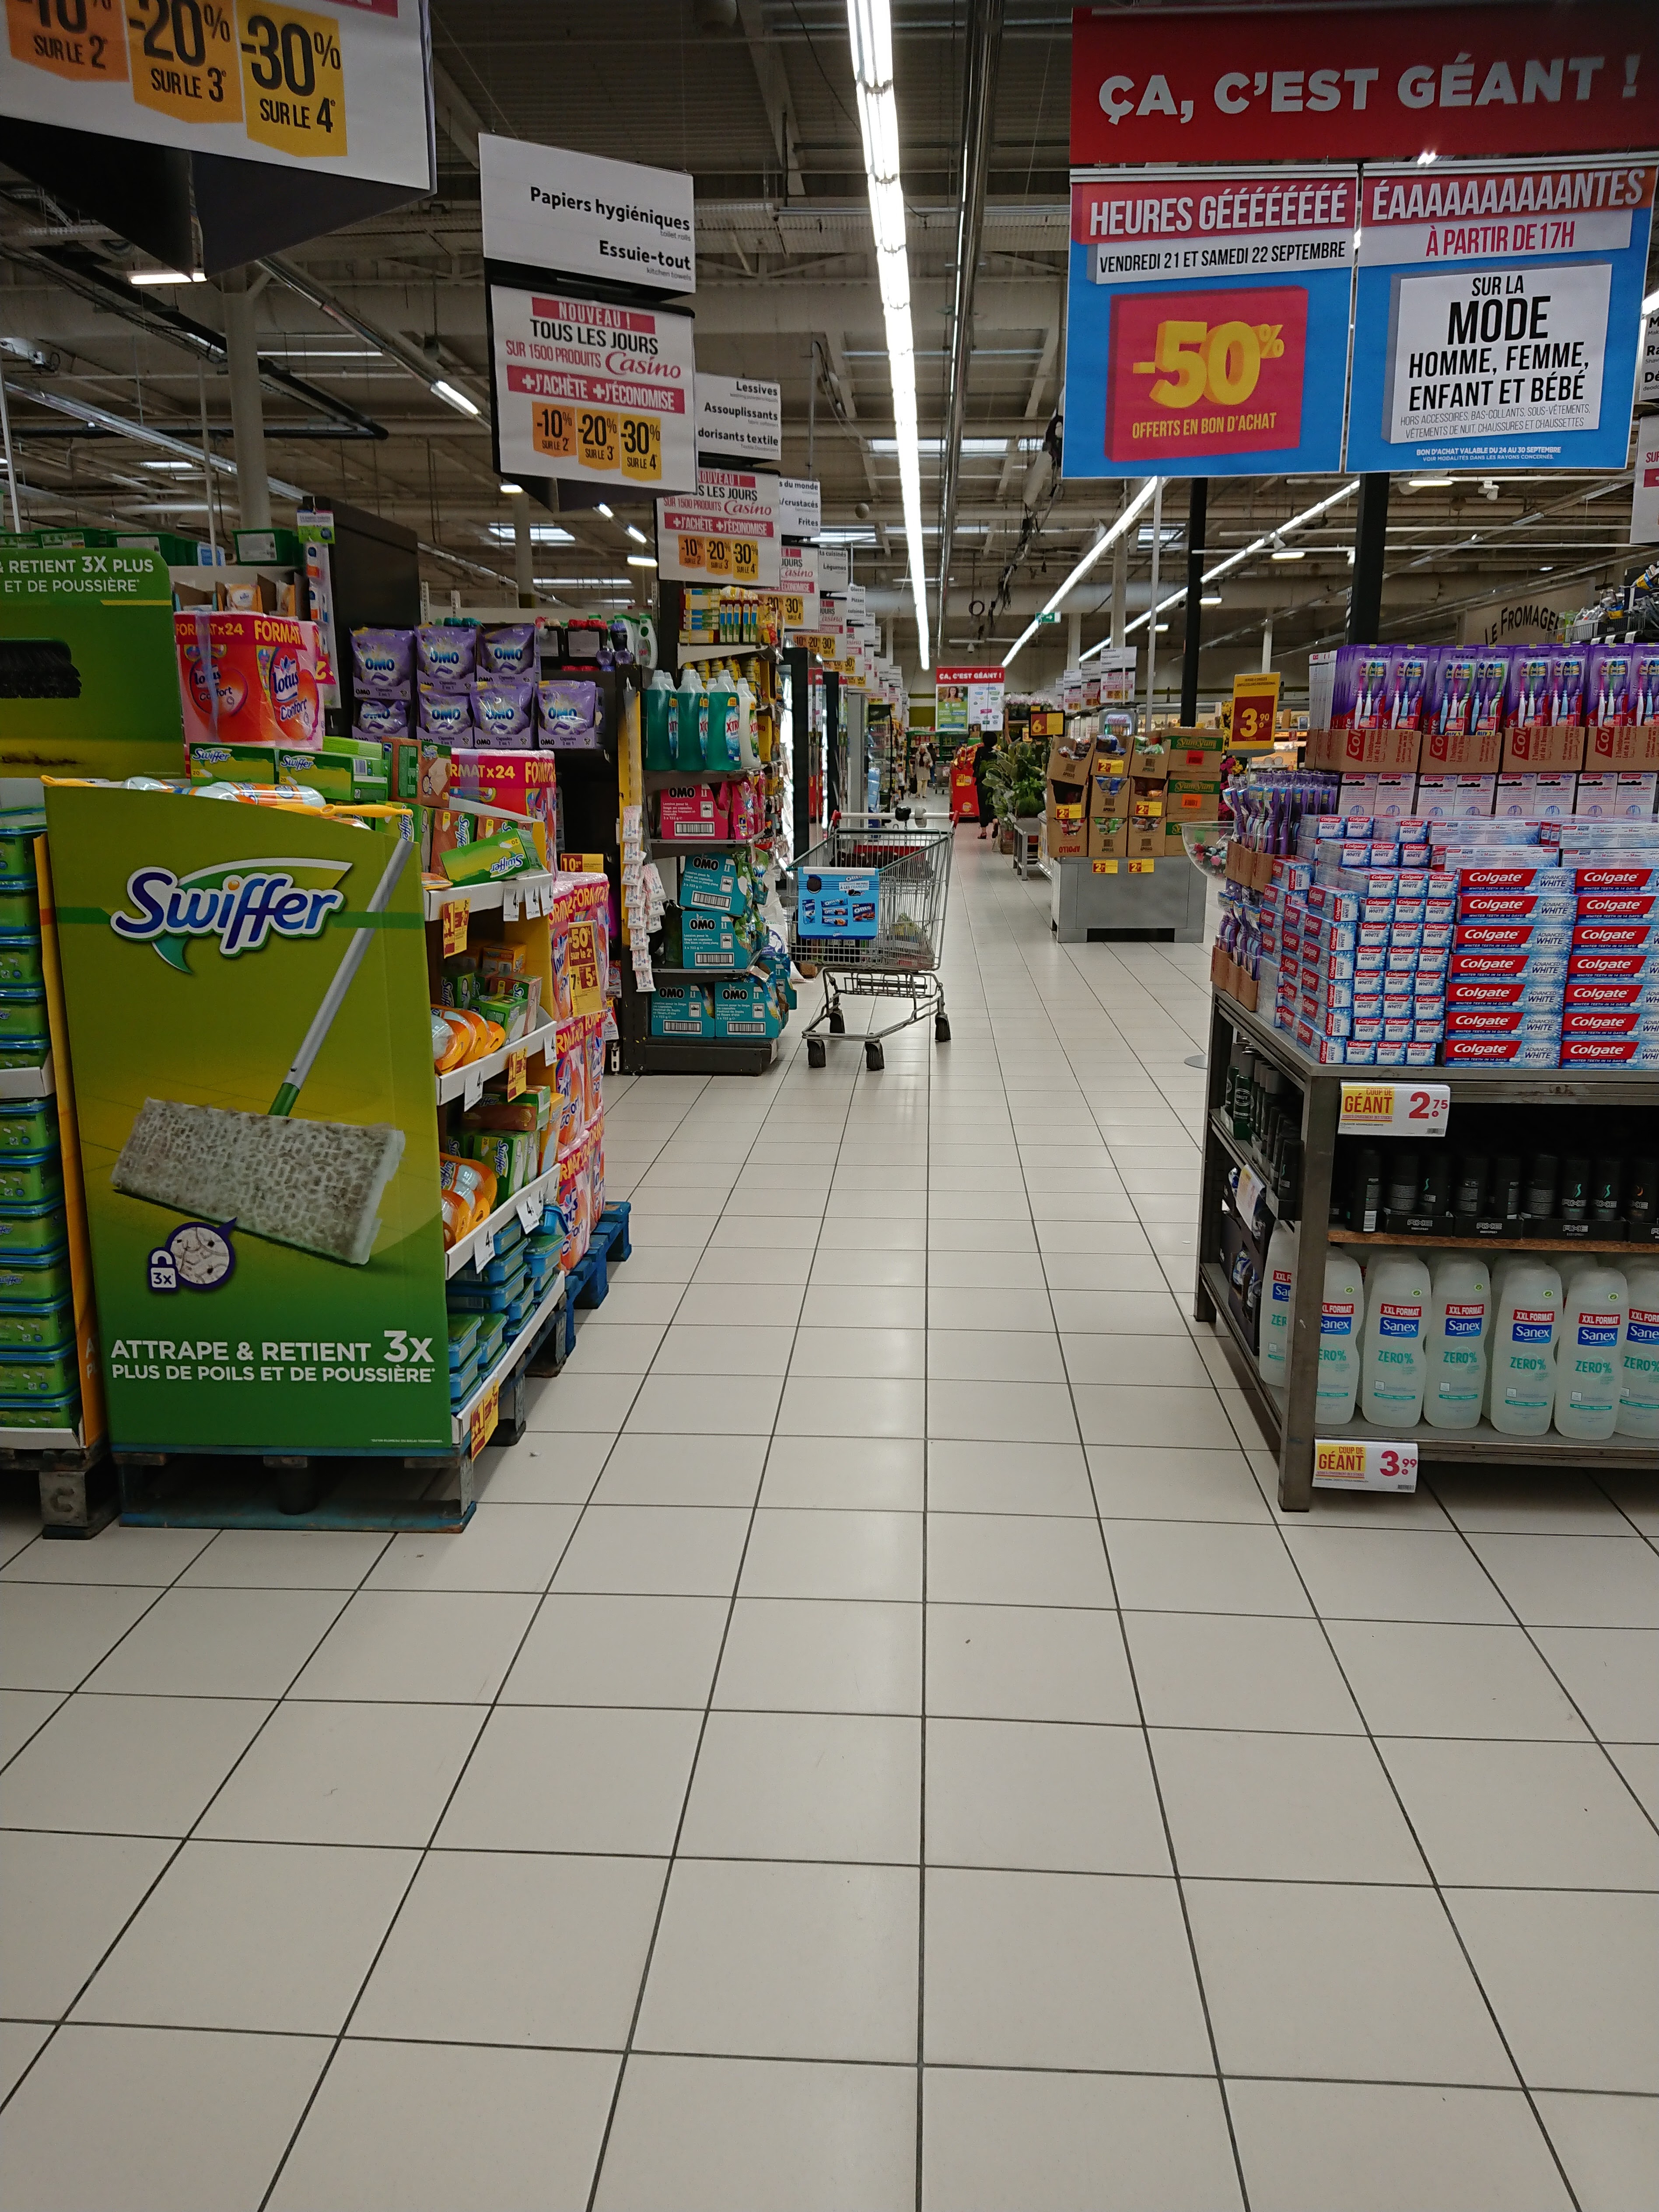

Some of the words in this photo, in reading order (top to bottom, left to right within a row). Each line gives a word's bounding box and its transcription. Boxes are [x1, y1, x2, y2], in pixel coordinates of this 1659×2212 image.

[33, 35, 64, 61] SUR
[66, 42, 85, 65] LE
[242, 15, 341, 97] -30%
[150, 68, 182, 96] SUR
[183, 74, 203, 99] LE
[1099, 75, 1194, 125] ÇA,
[1214, 68, 1379, 114] C'EST
[1398, 52, 1605, 109] GÉANT
[260, 98, 290, 126] SUR
[293, 104, 311, 130] LE
[530, 186, 592, 212] Papiers
[595, 199, 690, 231] hygiéniques
[1090, 196, 1193, 237] HEURES
[1425, 225, 1438, 257] À
[1444, 225, 1508, 256] PARTIR
[1512, 224, 1537, 251] DE
[1540, 220, 1575, 249] 17H
[599, 240, 692, 271] Essuie-tout
[1100, 252, 1160, 273] VENDREDI
[1164, 252, 1179, 268] 21
[1183, 250, 1199, 268] ET
[1201, 247, 1249, 267] SAMEDI
[1252, 246, 1268, 263] 22
[1271, 241, 1346, 262] SEPTEMBRE
[1471, 276, 1502, 297] SUR
[1505, 275, 1525, 294] LA
[558, 301, 621, 327] NOUVEAU
[1447, 295, 1551, 346] MODE
[529, 318, 574, 343] TOUS
[578, 326, 607, 347] LES
[612, 332, 659, 355] JOURS
[506, 340, 526, 358] SUR
[528, 343, 554, 361] 1500
[556, 348, 601, 369] PRODUITS
[605, 351, 682, 379] Casino
[1133, 320, 1284, 409] -50%
[1408, 348, 1497, 379] HOMME,
[1506, 341, 1589, 371] FEMME,
[736, 381, 778, 396] Lessives
[1409, 380, 1493, 412] ENFANT
[1499, 378, 1526, 405] ET
[1531, 370, 1586, 402] BÉBÉ
[705, 402, 778, 421] Assouplissants
[1133, 420, 1180, 439] OFFERTS
[1183, 419, 1198, 436] EN
[1201, 417, 1224, 434] BON
[1227, 413, 1277, 433] D'ACHAT
[1400, 416, 1419, 427] HORS
[1406, 425, 1448, 439] VÊTEMENTS
[1449, 425, 1458, 435] DE
[1477, 420, 1523, 433] CHAUSSURES
[1524, 420, 1534, 430] ET
[1535, 416, 1584, 429] CHAUSSETTES
[537, 409, 572, 438] -10%
[578, 413, 617, 446] -20%
[620, 420, 661, 455] -30%
[747, 432, 778, 446] textile
[542, 439, 553, 449] SUR
[585, 449, 598, 459] SUR
[627, 457, 640, 468] SUR
[707, 486, 725, 498] LES
[728, 488, 758, 501] JOURS
[795, 481, 818, 490] monde
[693, 499, 721, 511] PRODUITS
[724, 500, 772, 516] Casino
[798, 517, 818, 526] Frites
[9, 559, 76, 574] RETIENT
[113, 558, 154, 573] PLUS
[4, 580, 22, 592] ET
[28, 579, 48, 592] DE
[430, 651, 459, 664] OMO
[494, 648, 523, 661] OMO
[365, 658, 394, 672] OMO
[192, 748, 231, 763] Swiffer
[281, 755, 316, 771] Swiffer
[1469, 872, 1522, 884] Colgate
[1584, 872, 1637, 884] Colgate
[112, 869, 341, 953] Swiffer
[1470, 899, 1523, 911] Colgate
[1587, 900, 1640, 912] Colgate
[1366, 1088, 1382, 1096] COUP
[1344, 1093, 1393, 1113] GÉANT
[1383, 1306, 1396, 1314] XXL
[1396, 1306, 1420, 1316] FORMAT
[1449, 1306, 1461, 1314] XXL
[1462, 1305, 1483, 1314] FORMAT
[1516, 1311, 1529, 1320] XXL
[1383, 1321, 1417, 1333] Sanex
[1448, 1320, 1480, 1331] Sanex
[1516, 1326, 1550, 1338] Sanex
[1581, 1329, 1616, 1341] Sanex
[111, 1339, 229, 1361] ATTRAPE
[237, 1342, 254, 1361] &
[262, 1342, 371, 1362] RETIENT
[112, 1363, 160, 1379] PLUS
[166, 1366, 192, 1381] DE
[198, 1366, 255, 1382] POILS
[260, 1366, 284, 1381] ET
[291, 1367, 317, 1382] DE
[1356, 1446, 1364, 1455] DE
[1319, 1451, 1365, 1471] GÉANT
